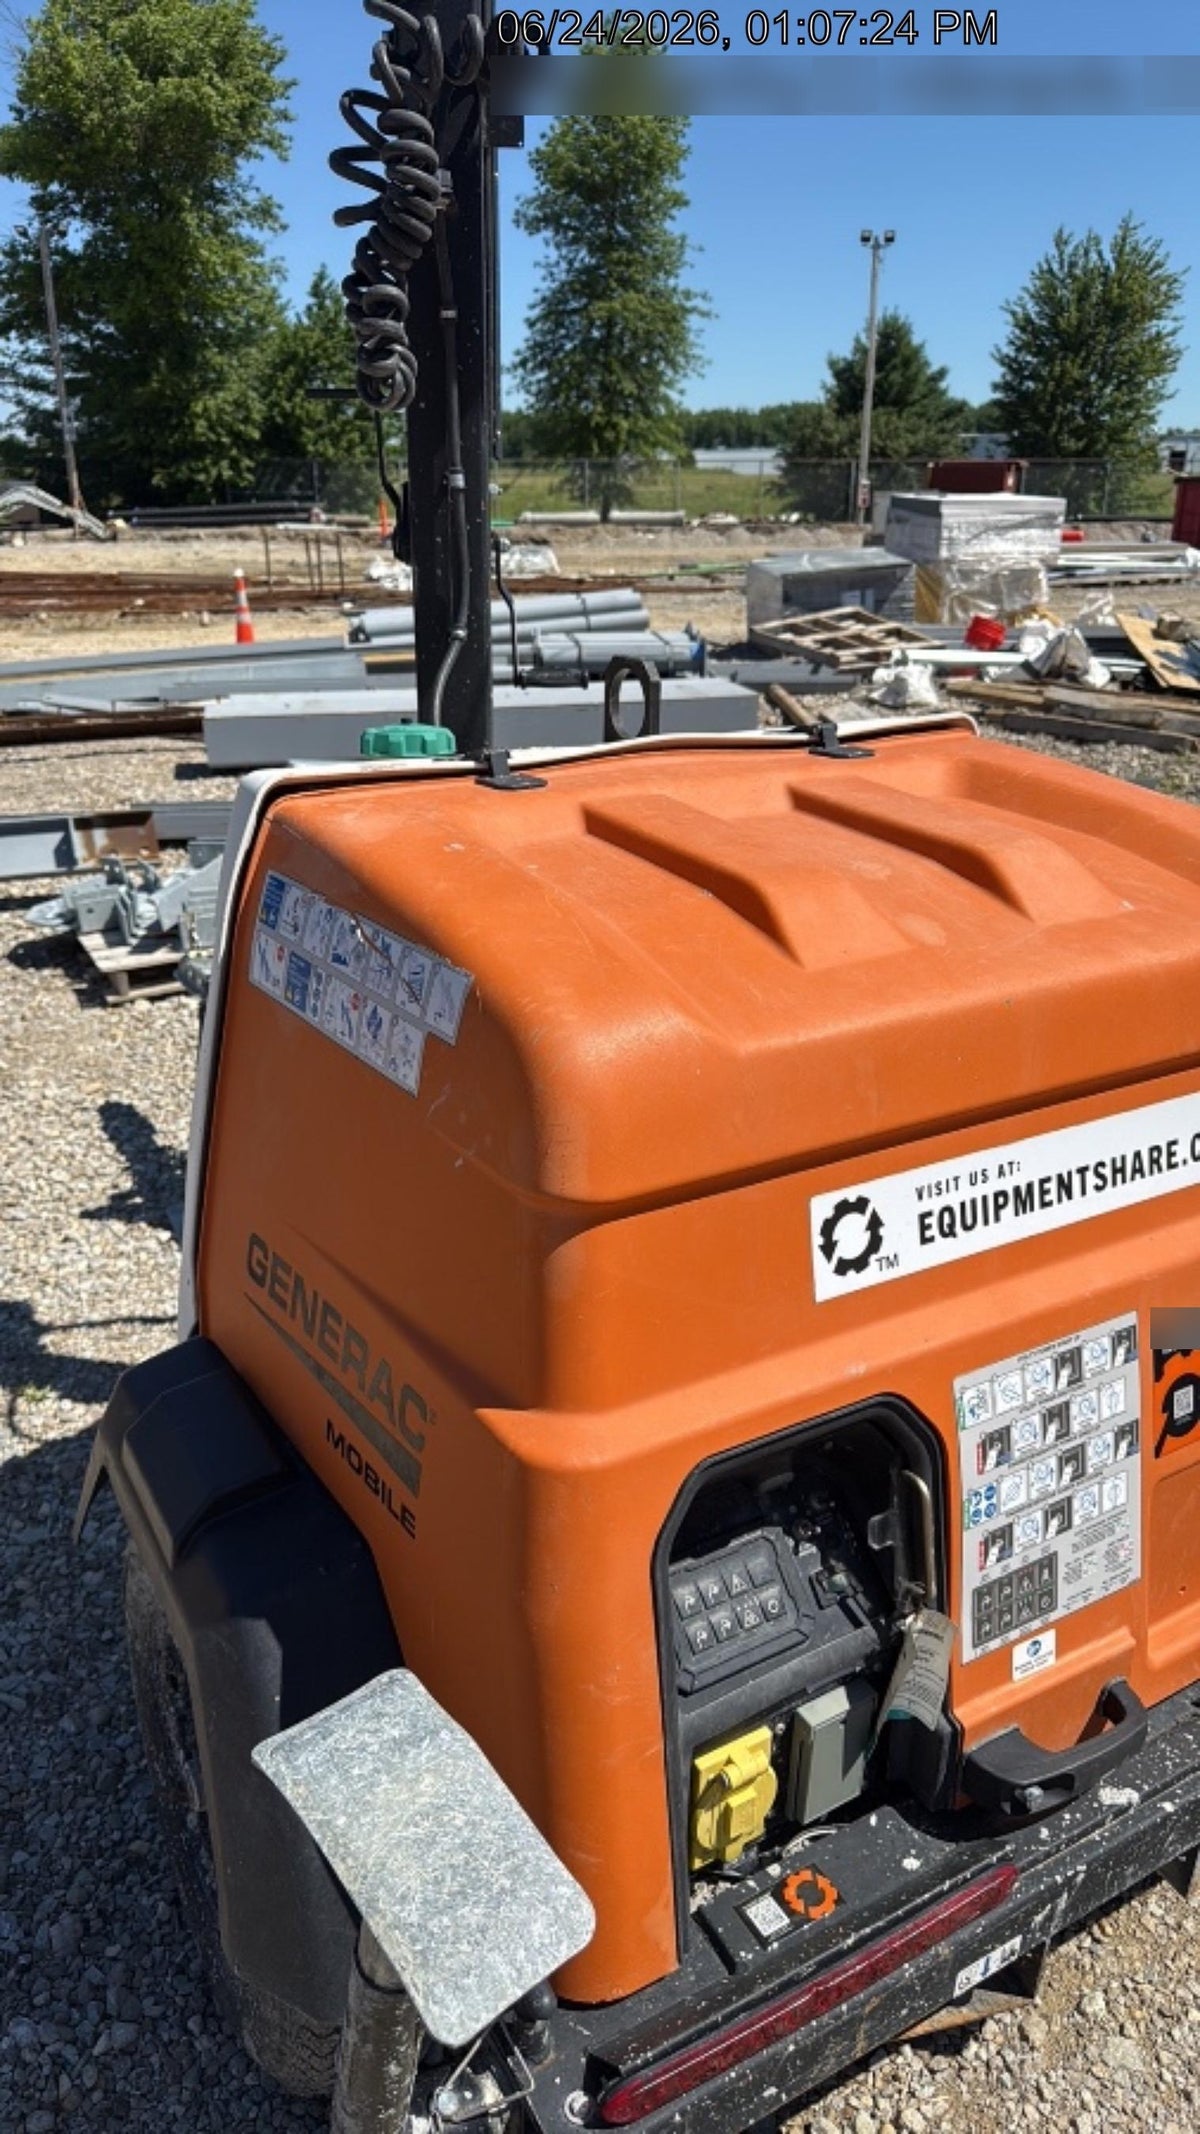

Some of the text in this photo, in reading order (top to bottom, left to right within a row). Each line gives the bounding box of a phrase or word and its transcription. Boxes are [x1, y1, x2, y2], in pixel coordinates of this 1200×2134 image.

[915, 1160, 1021, 1202] VISIT US AT:
[876, 1252, 900, 1272] TM
[247, 1233, 427, 1451] GENERAC
[325, 1418, 417, 1539] MOBILE
